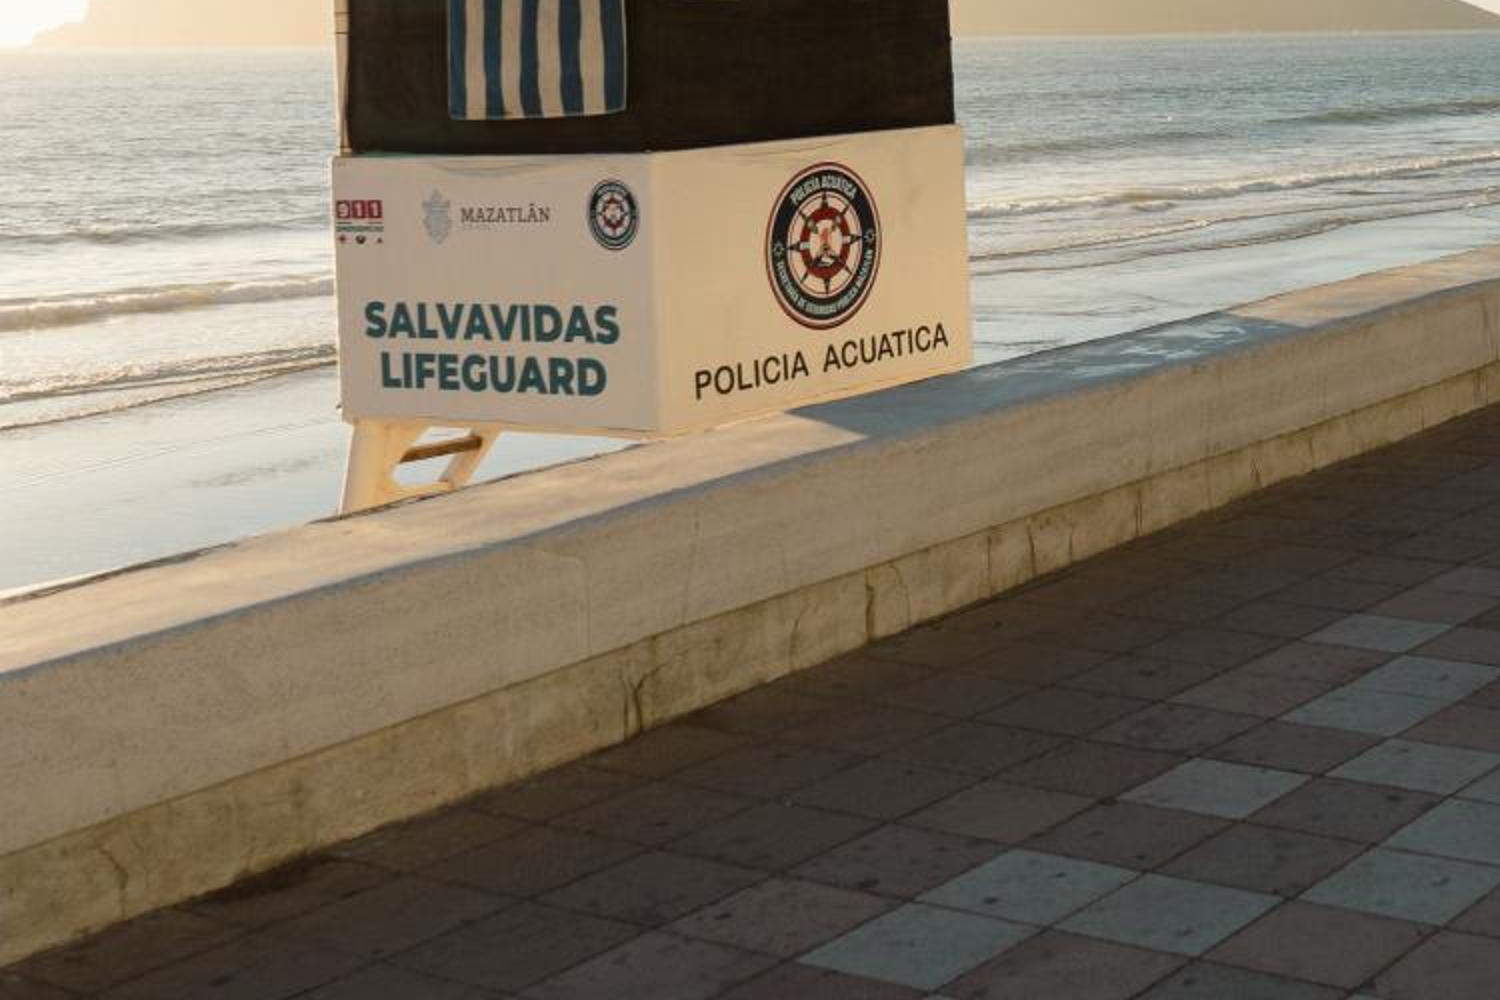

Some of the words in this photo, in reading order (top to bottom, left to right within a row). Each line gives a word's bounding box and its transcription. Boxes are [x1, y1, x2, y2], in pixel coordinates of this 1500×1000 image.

[336, 200, 382, 219] 911
[364, 301, 620, 345] SALVAVIDAS
[381, 352, 607, 396] LIFEGUARD
[695, 351, 809, 400] POLICIA
[823, 323, 949, 372] ACUATICA
